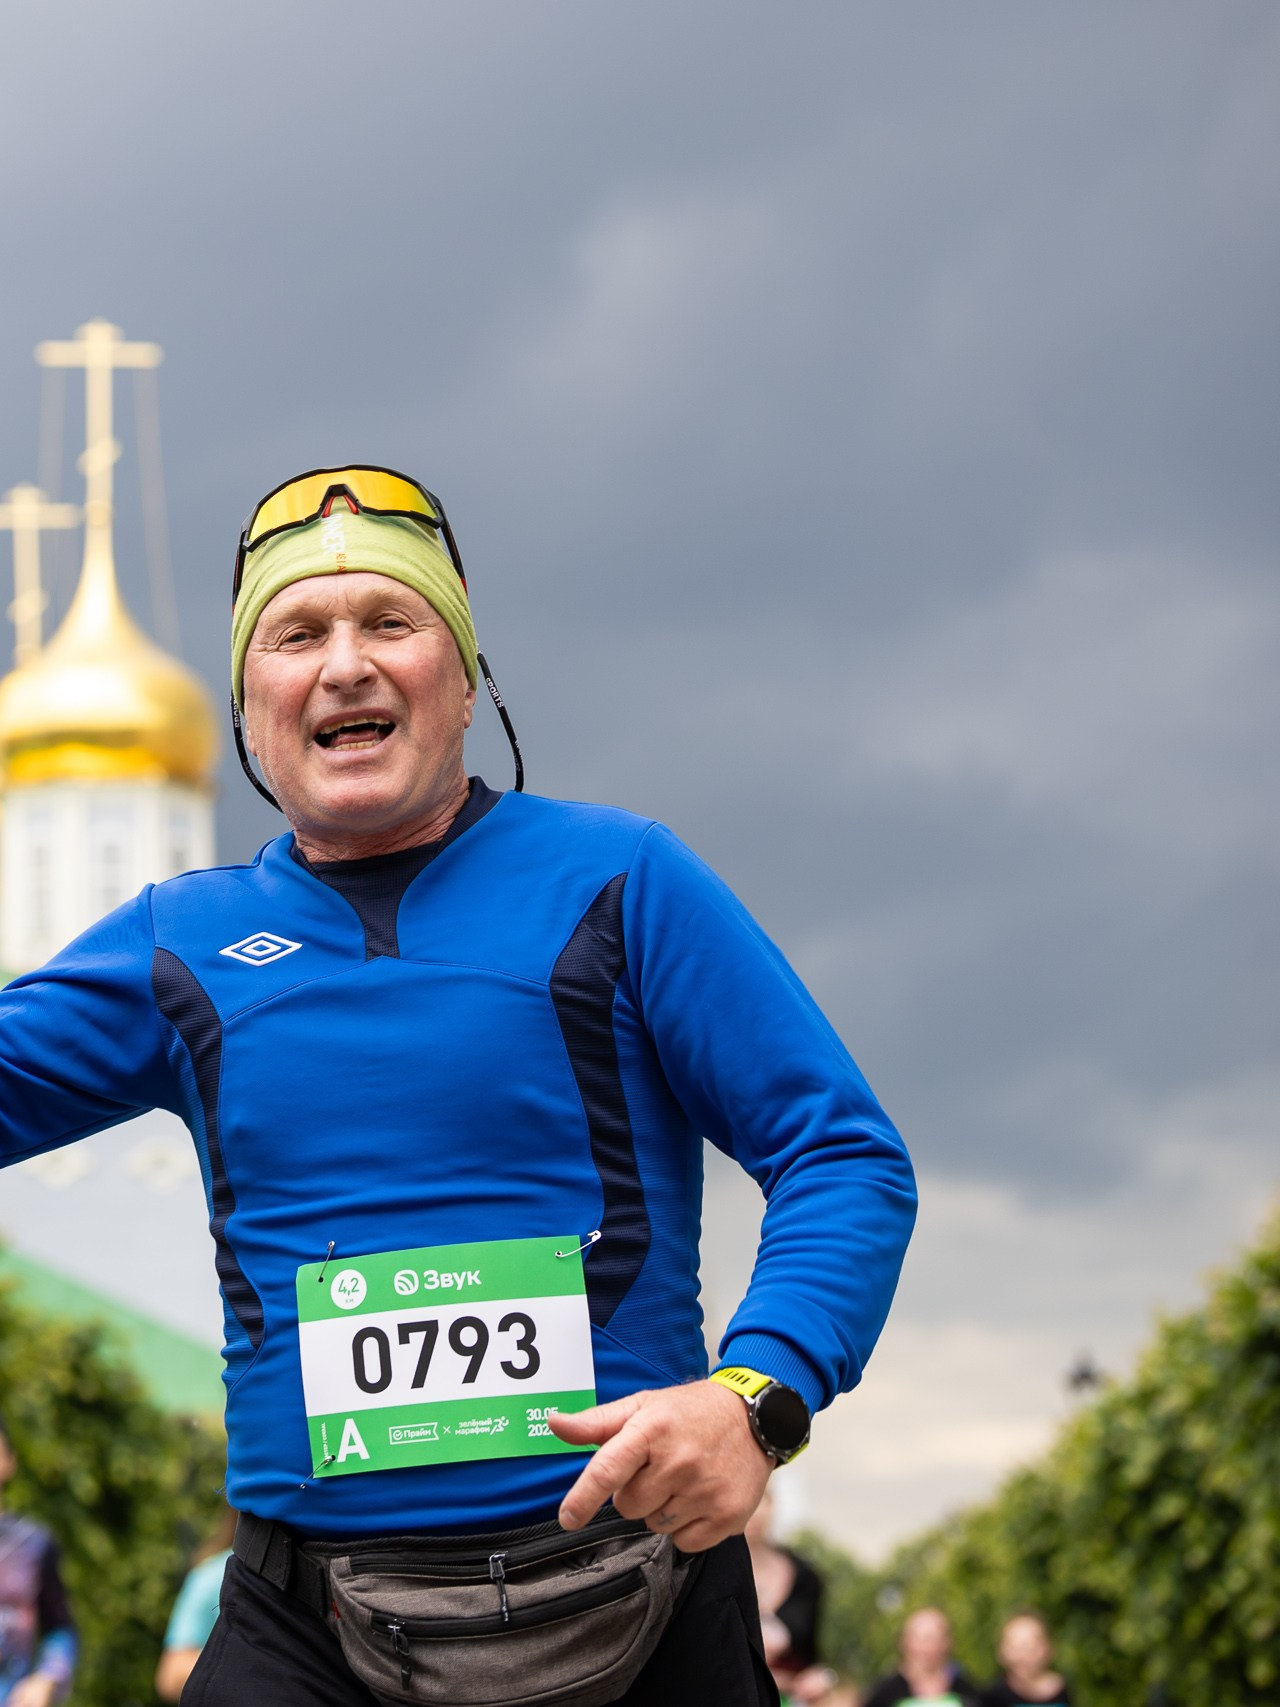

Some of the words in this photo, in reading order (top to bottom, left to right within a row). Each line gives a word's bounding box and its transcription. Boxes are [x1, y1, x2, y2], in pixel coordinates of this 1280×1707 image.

[486, 677, 505, 709] SPORTS
[233, 699, 241, 728] SPORT
[423, 1269, 482, 1291] Звук
[352, 1312, 541, 1394] 0793
[404, 1428, 432, 1439] Прайм
[528, 1423, 554, 1437] 202
